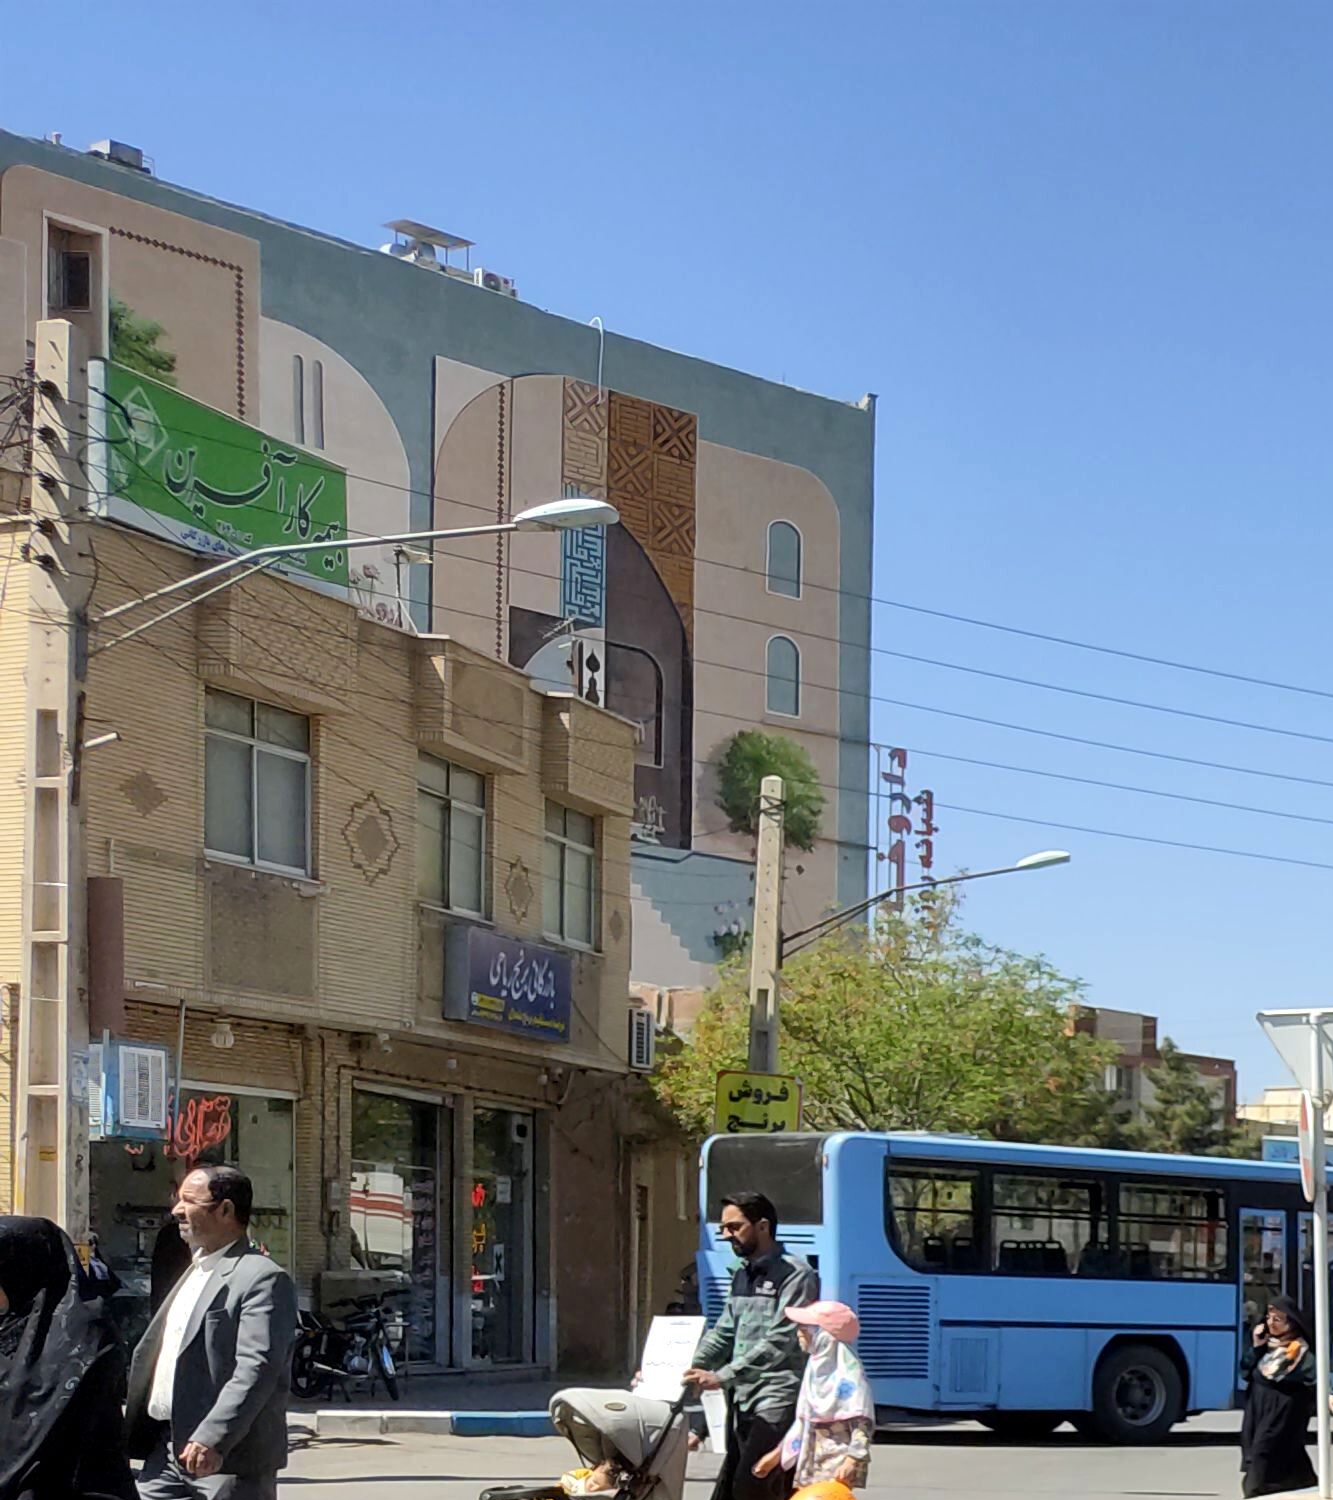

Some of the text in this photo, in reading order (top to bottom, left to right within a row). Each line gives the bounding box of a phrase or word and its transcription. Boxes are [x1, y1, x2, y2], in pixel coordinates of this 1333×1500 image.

[877, 747, 912, 913] داروخ
[727, 1079, 790, 1106] فروش
[726, 1112, 787, 1133] برنج
